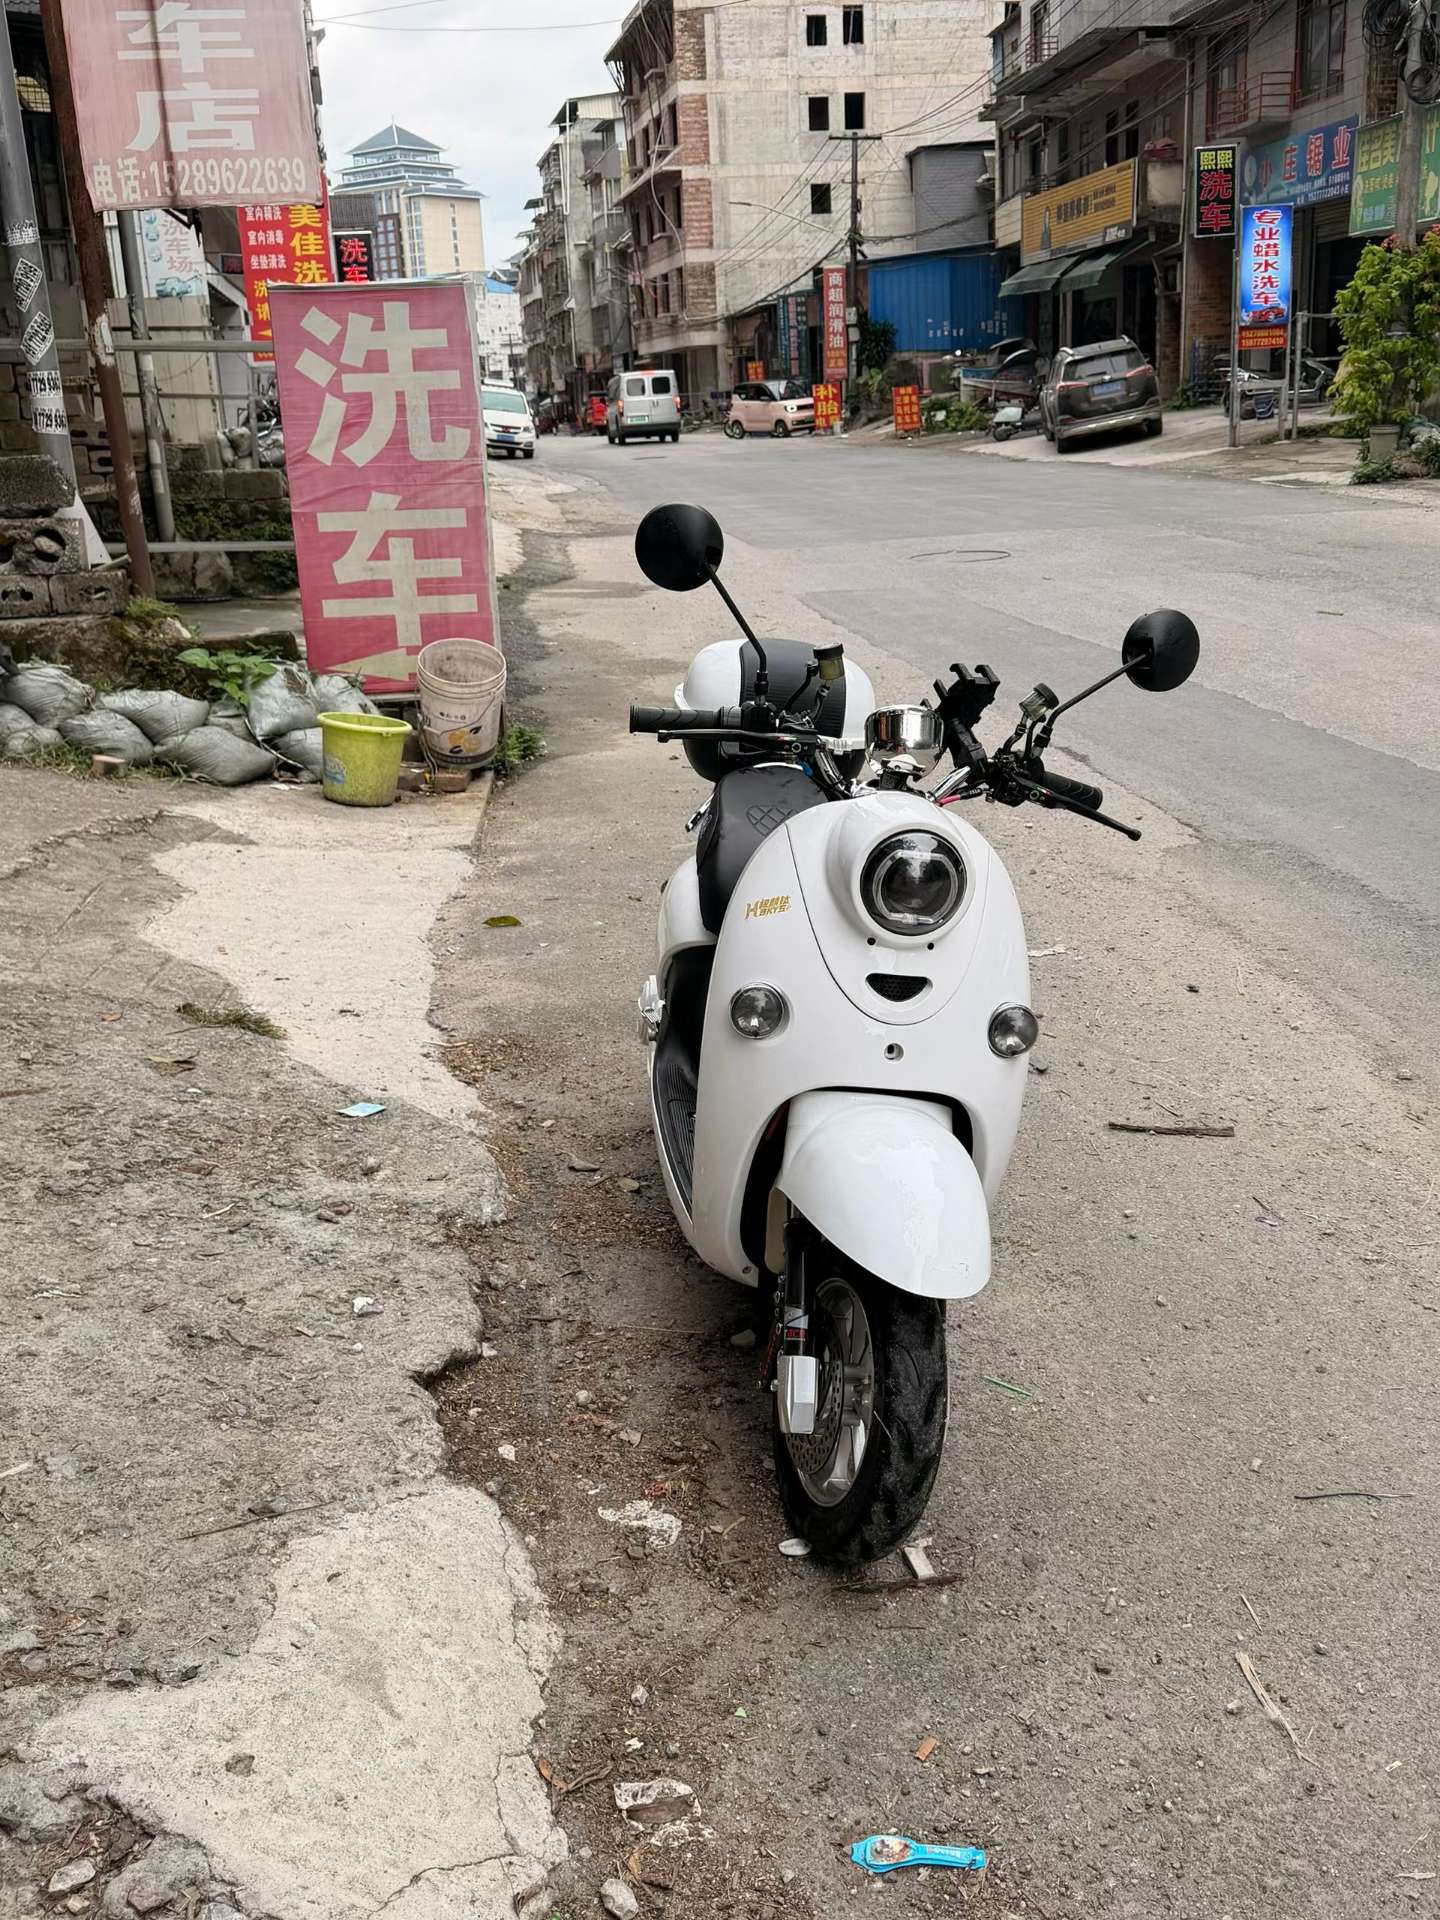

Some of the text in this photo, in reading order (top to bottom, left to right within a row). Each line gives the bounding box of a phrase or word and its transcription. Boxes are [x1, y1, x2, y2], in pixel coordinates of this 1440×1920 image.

[116, 1, 260, 152] 车店
[1200, 170, 1233, 232] 洗车
[339, 238, 369, 284] 洗车
[1252, 210, 1282, 305] 专业蜡水洗车
[828, 271, 844, 348] 商超润滑油
[294, 301, 479, 647] 洗车
